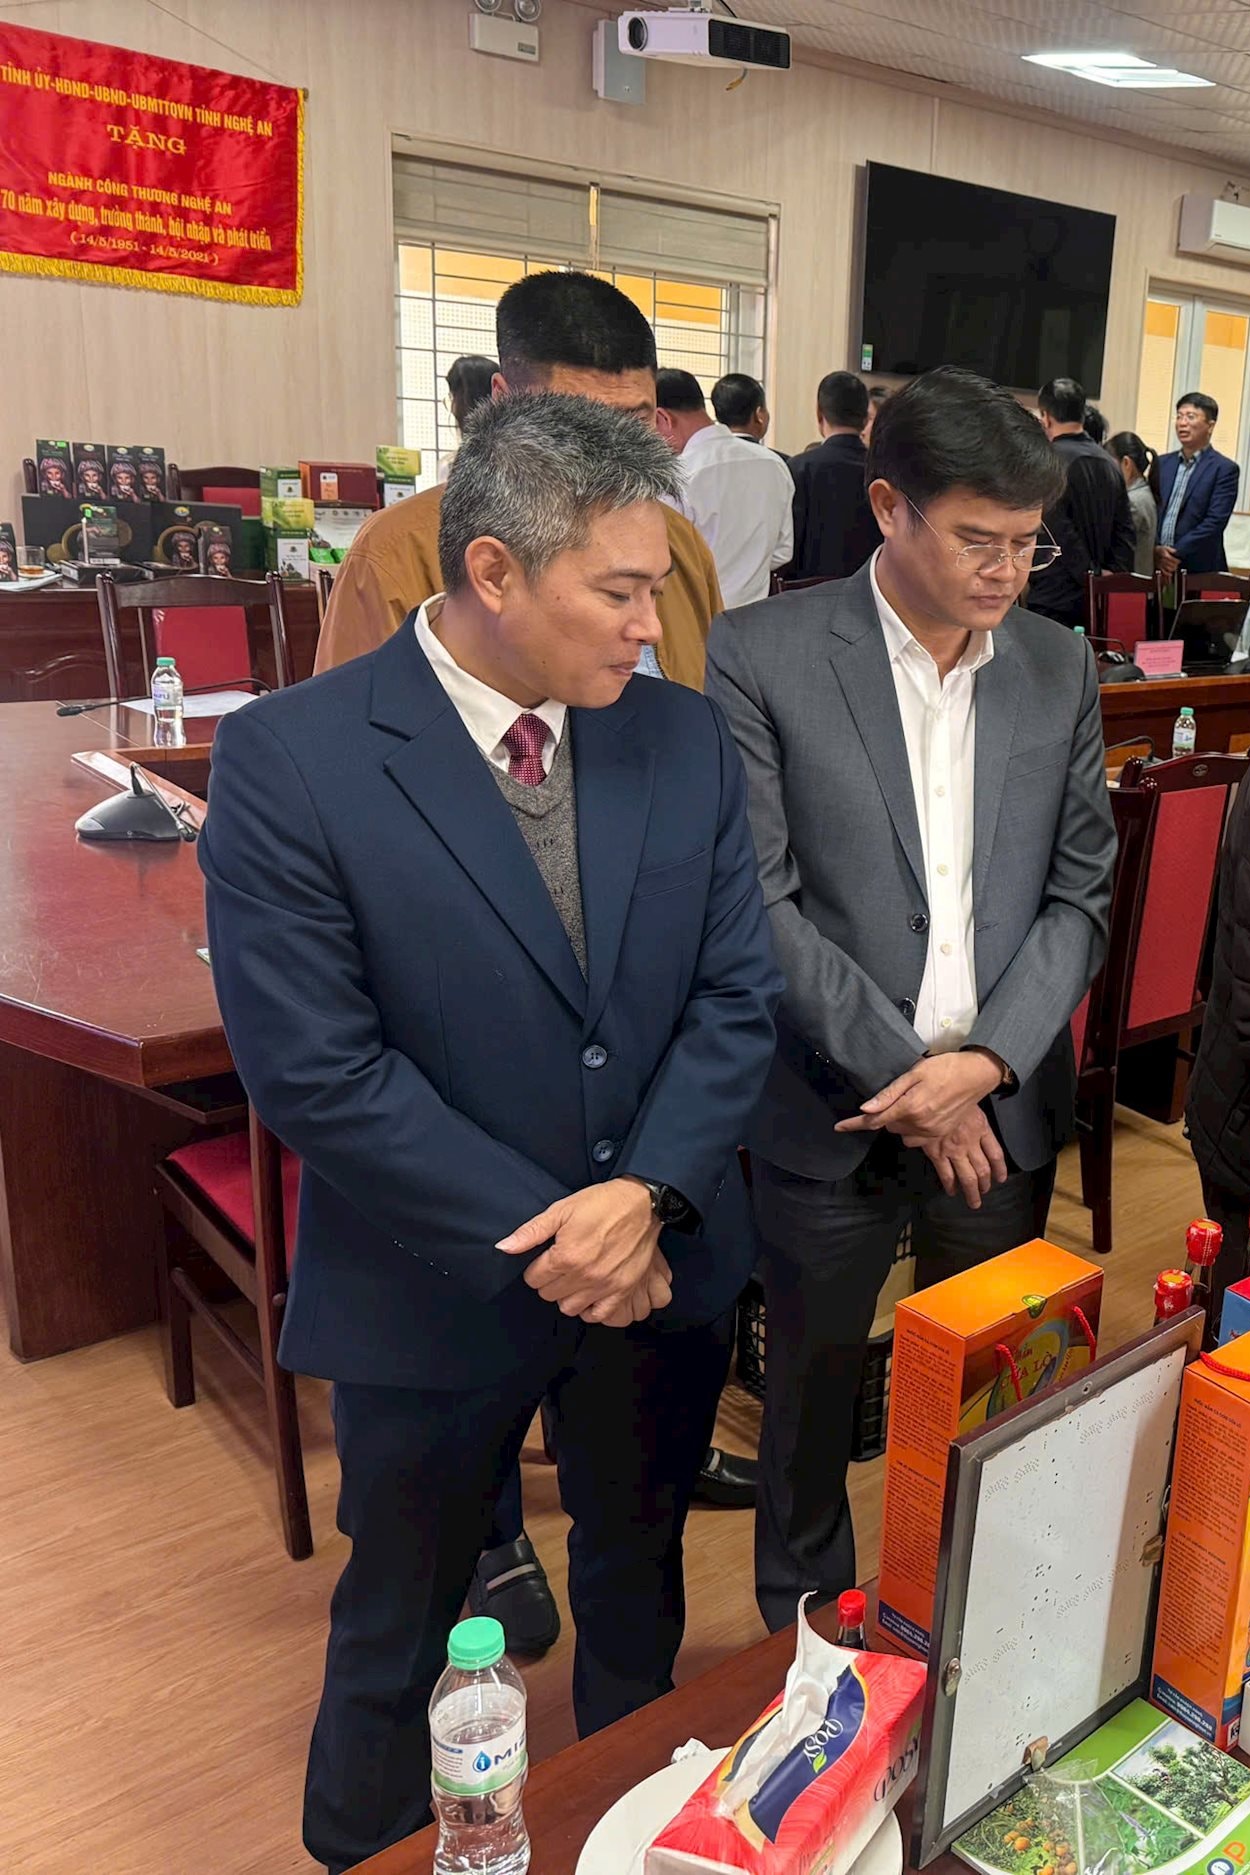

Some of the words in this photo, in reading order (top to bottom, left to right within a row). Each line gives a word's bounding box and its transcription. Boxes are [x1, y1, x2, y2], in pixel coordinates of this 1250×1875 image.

[1, 61, 31, 87] TỈNH
[195, 104, 221, 127] TỈNH
[223, 114, 254, 136] NGHỆ
[256, 120, 272, 137] AN
[106, 124, 187, 155] TẶNG
[1, 189, 15, 211] 70
[18, 192, 43, 215] năm
[46, 197, 65, 221] xây
[212, 224, 225, 245] và
[47, 171, 93, 191] NGÀNH
[96, 178, 128, 197] CÔNG
[131, 185, 179, 206] THƯƠNG
[181, 192, 212, 214] NGHỆ
[214, 202, 232, 215] AN
